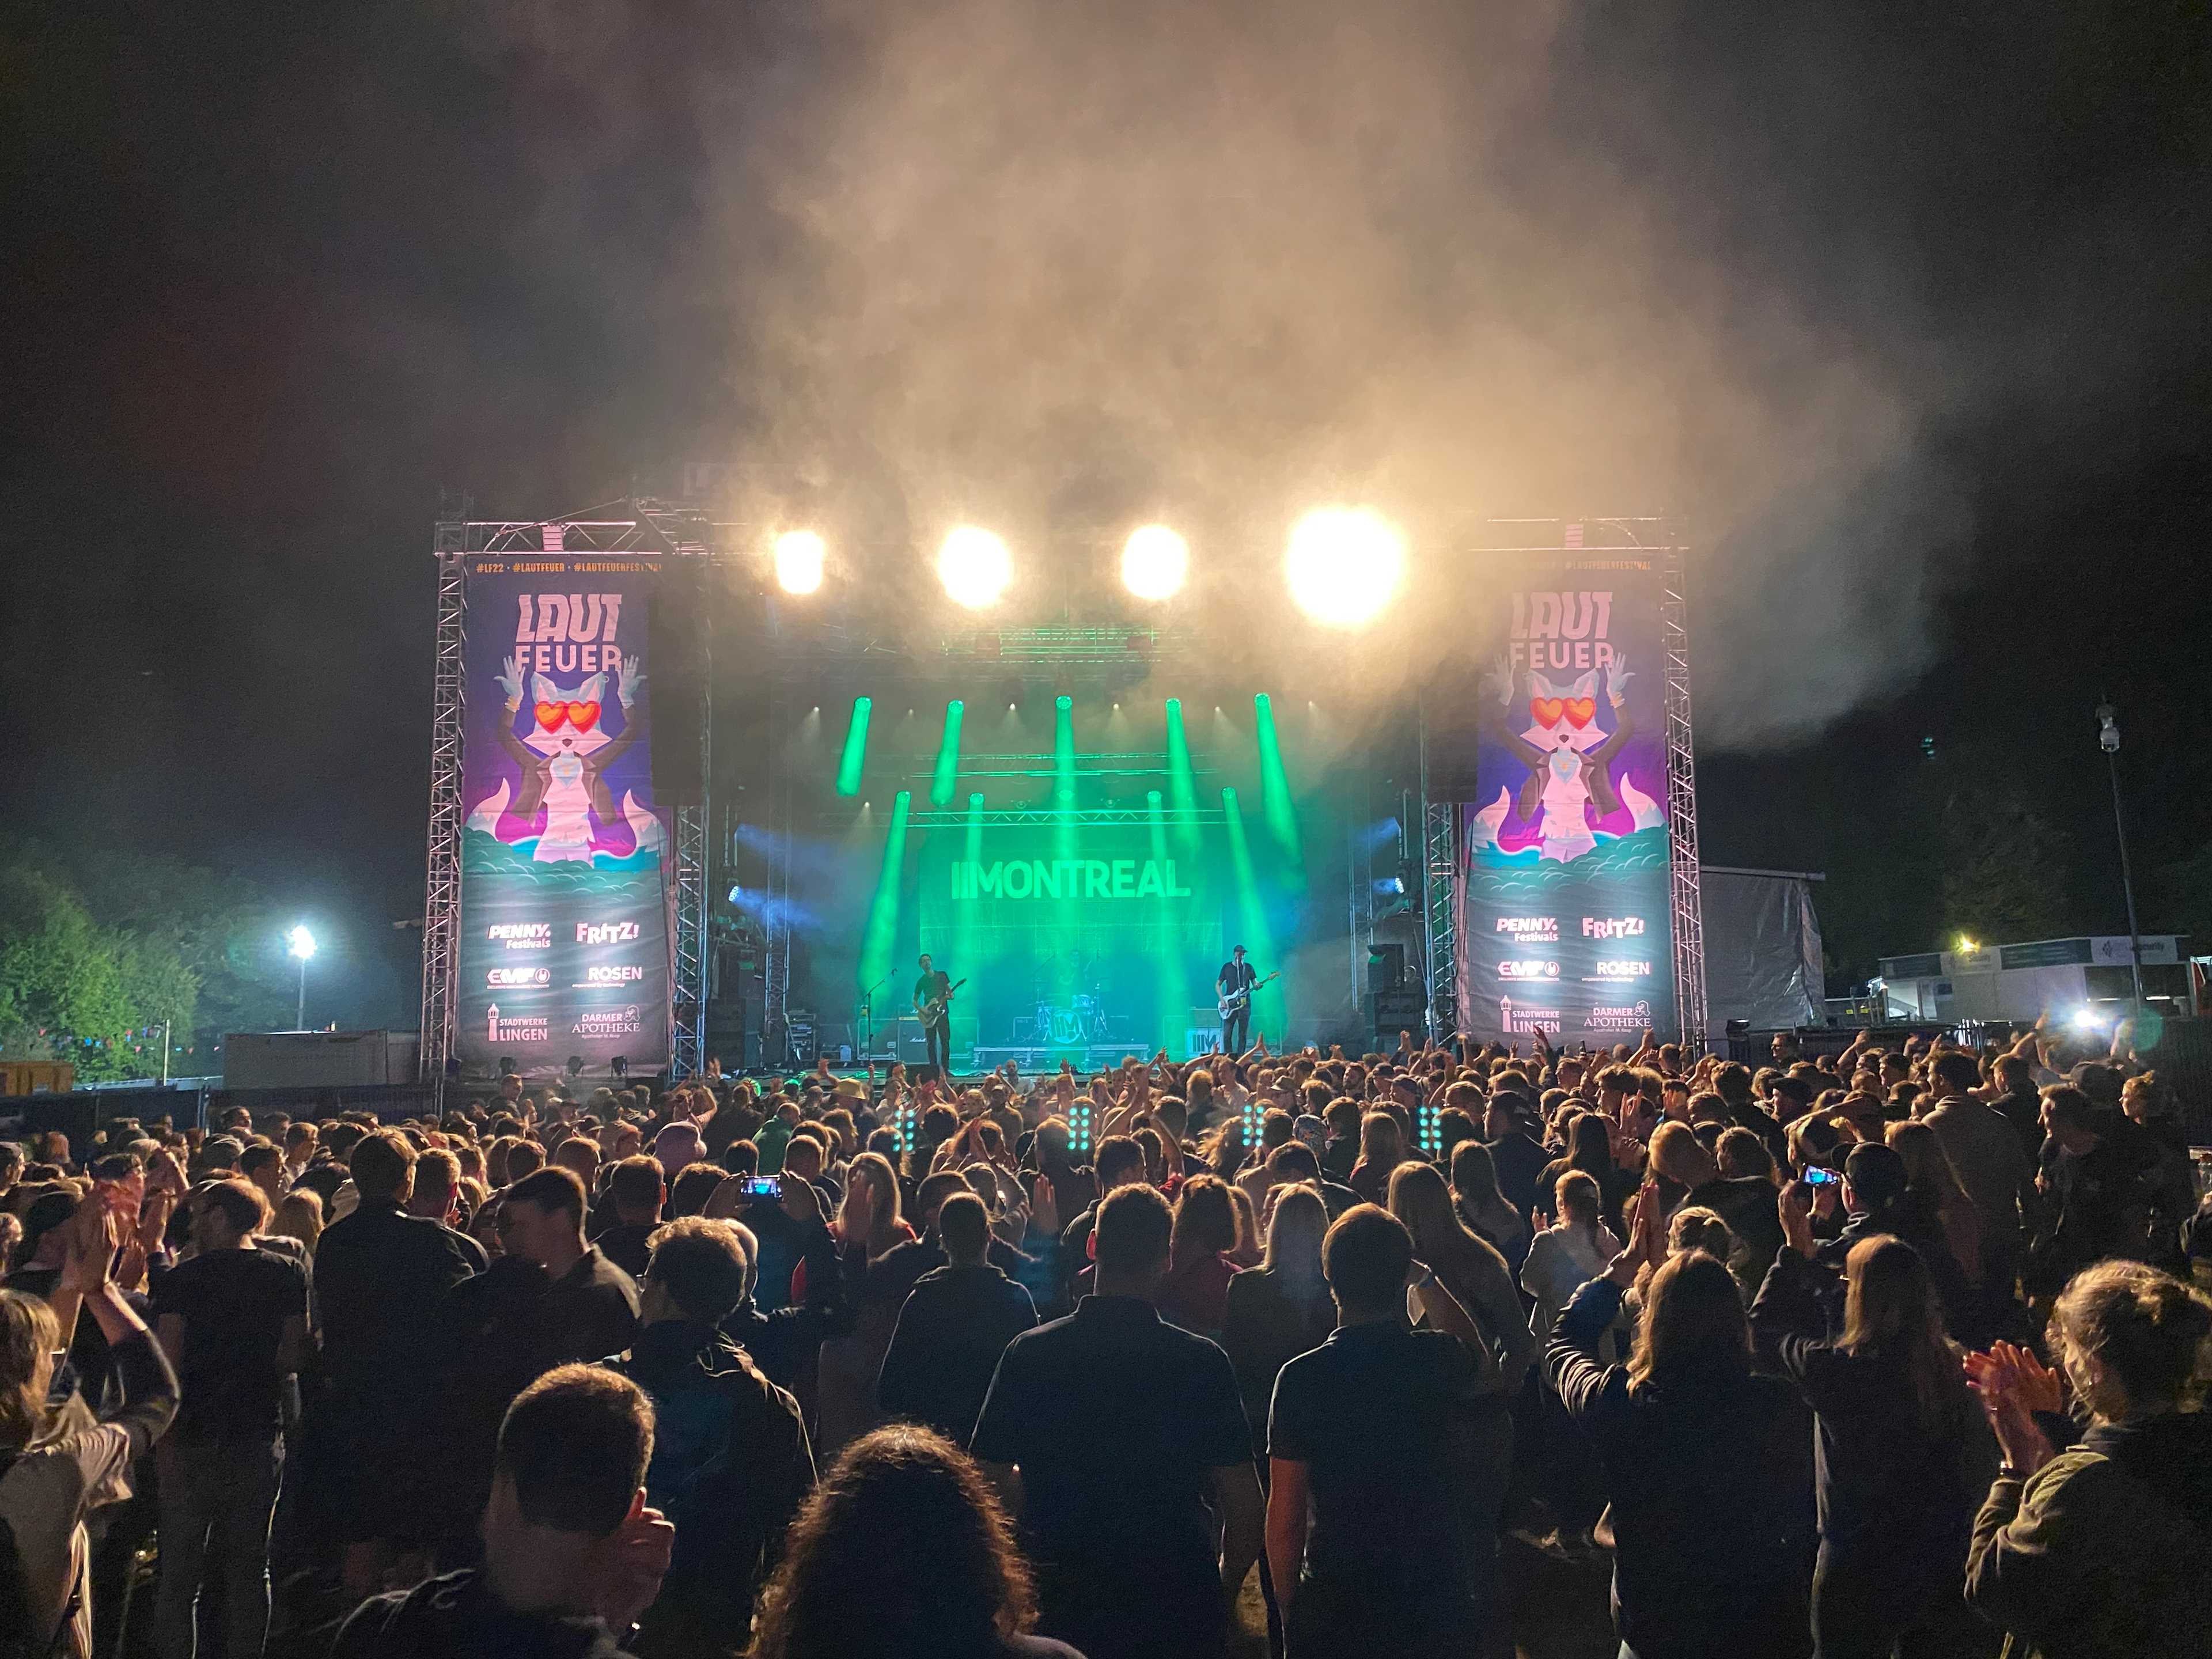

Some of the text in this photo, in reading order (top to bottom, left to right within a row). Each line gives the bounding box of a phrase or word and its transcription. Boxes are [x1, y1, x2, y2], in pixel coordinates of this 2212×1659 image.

[476, 563, 504, 573] #LF22
[513, 562, 565, 572] #LAUTFEUER
[516, 594, 622, 643] LAUT
[1510, 591, 1613, 639] LAUT
[516, 645, 622, 672] FEUER
[1510, 642, 1613, 669] FEUER
[1514, 932, 1558, 942] Festivals
[506, 938, 551, 949] Festivals
[588, 966, 642, 981] ROSEN
[1596, 961, 1650, 976] ROSEN
[1512, 1010, 1559, 1018] STADTWERKE
[1593, 1007, 1633, 1016] DARMER
[499, 1018, 547, 1026] STADTWERKE
[582, 1014, 623, 1022] DARMER
[1584, 1017, 1651, 1027] APOTHEKE
[571, 1022, 641, 1033] APOTHEKE
[499, 1028, 547, 1041] LINGEN
